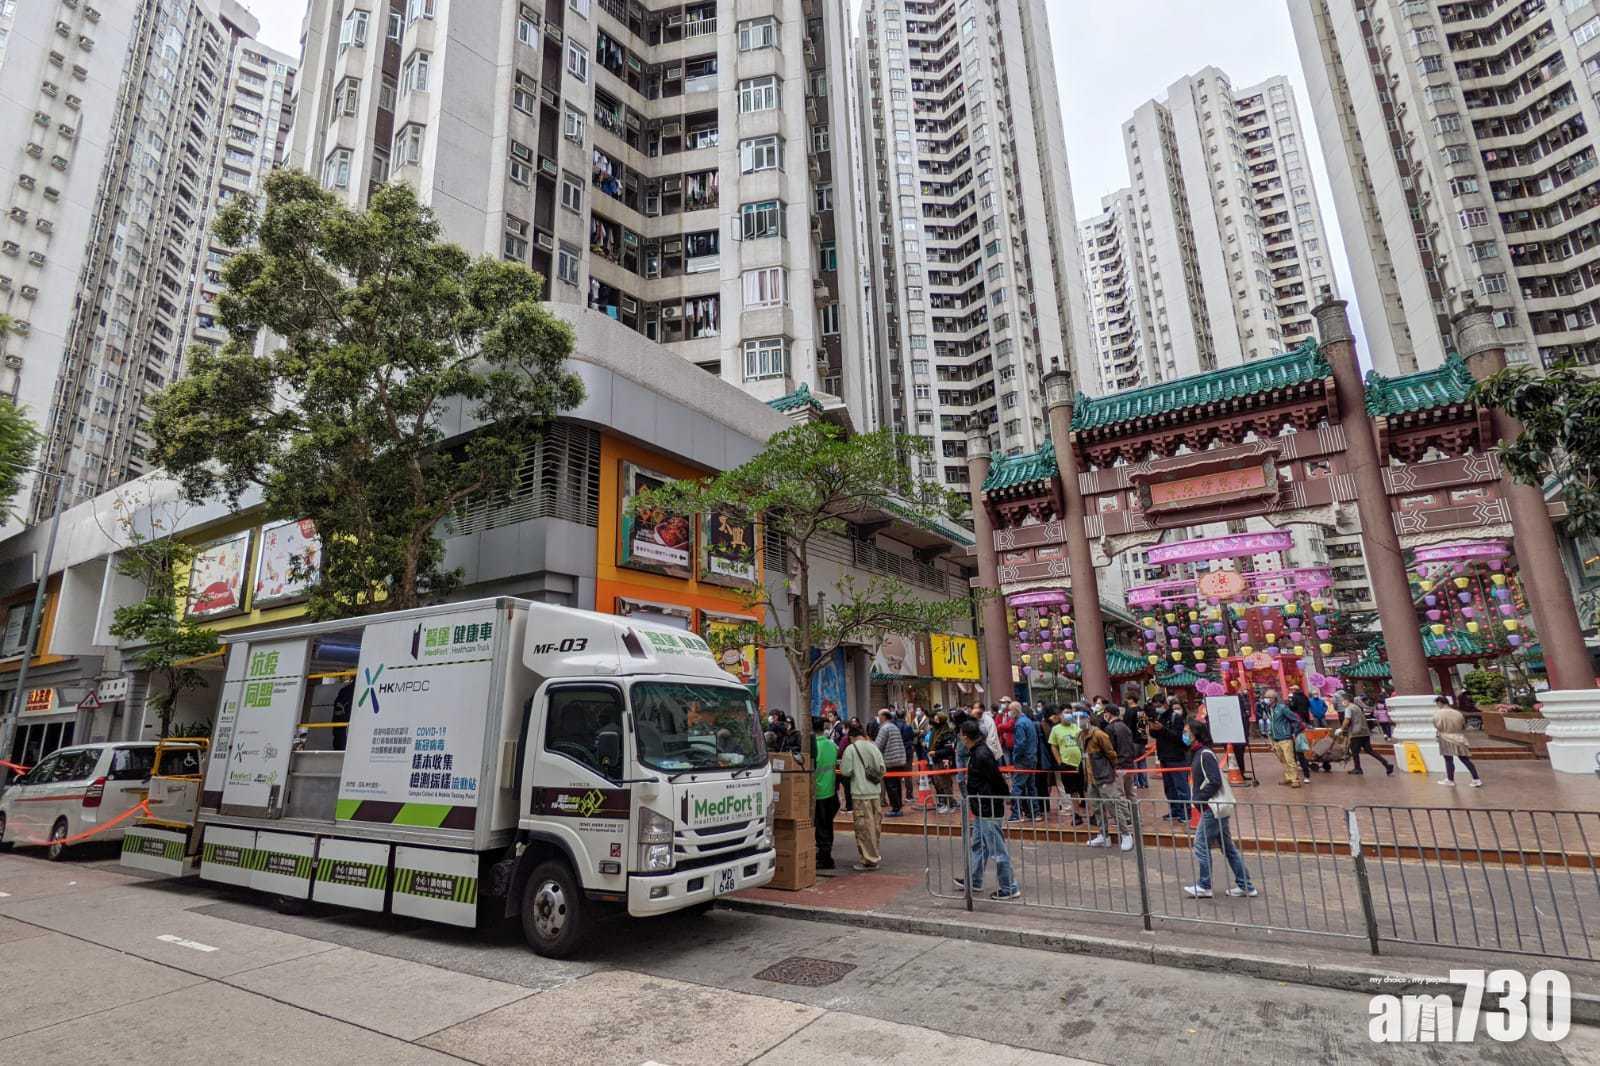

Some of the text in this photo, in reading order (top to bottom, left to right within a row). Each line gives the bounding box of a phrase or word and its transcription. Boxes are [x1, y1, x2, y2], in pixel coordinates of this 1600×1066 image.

[453, 622, 493, 644] 健康車
[533, 638, 588, 655] MF-03
[250, 649, 280, 676] 抗疫
[244, 682, 273, 707] 同盟
[379, 680, 430, 694] HKMPDC
[416, 727, 447, 737] COVID-19
[411, 754, 453, 770] 樣本收集
[694, 795, 752, 818] MedFort
[719, 878, 735, 892] 648
